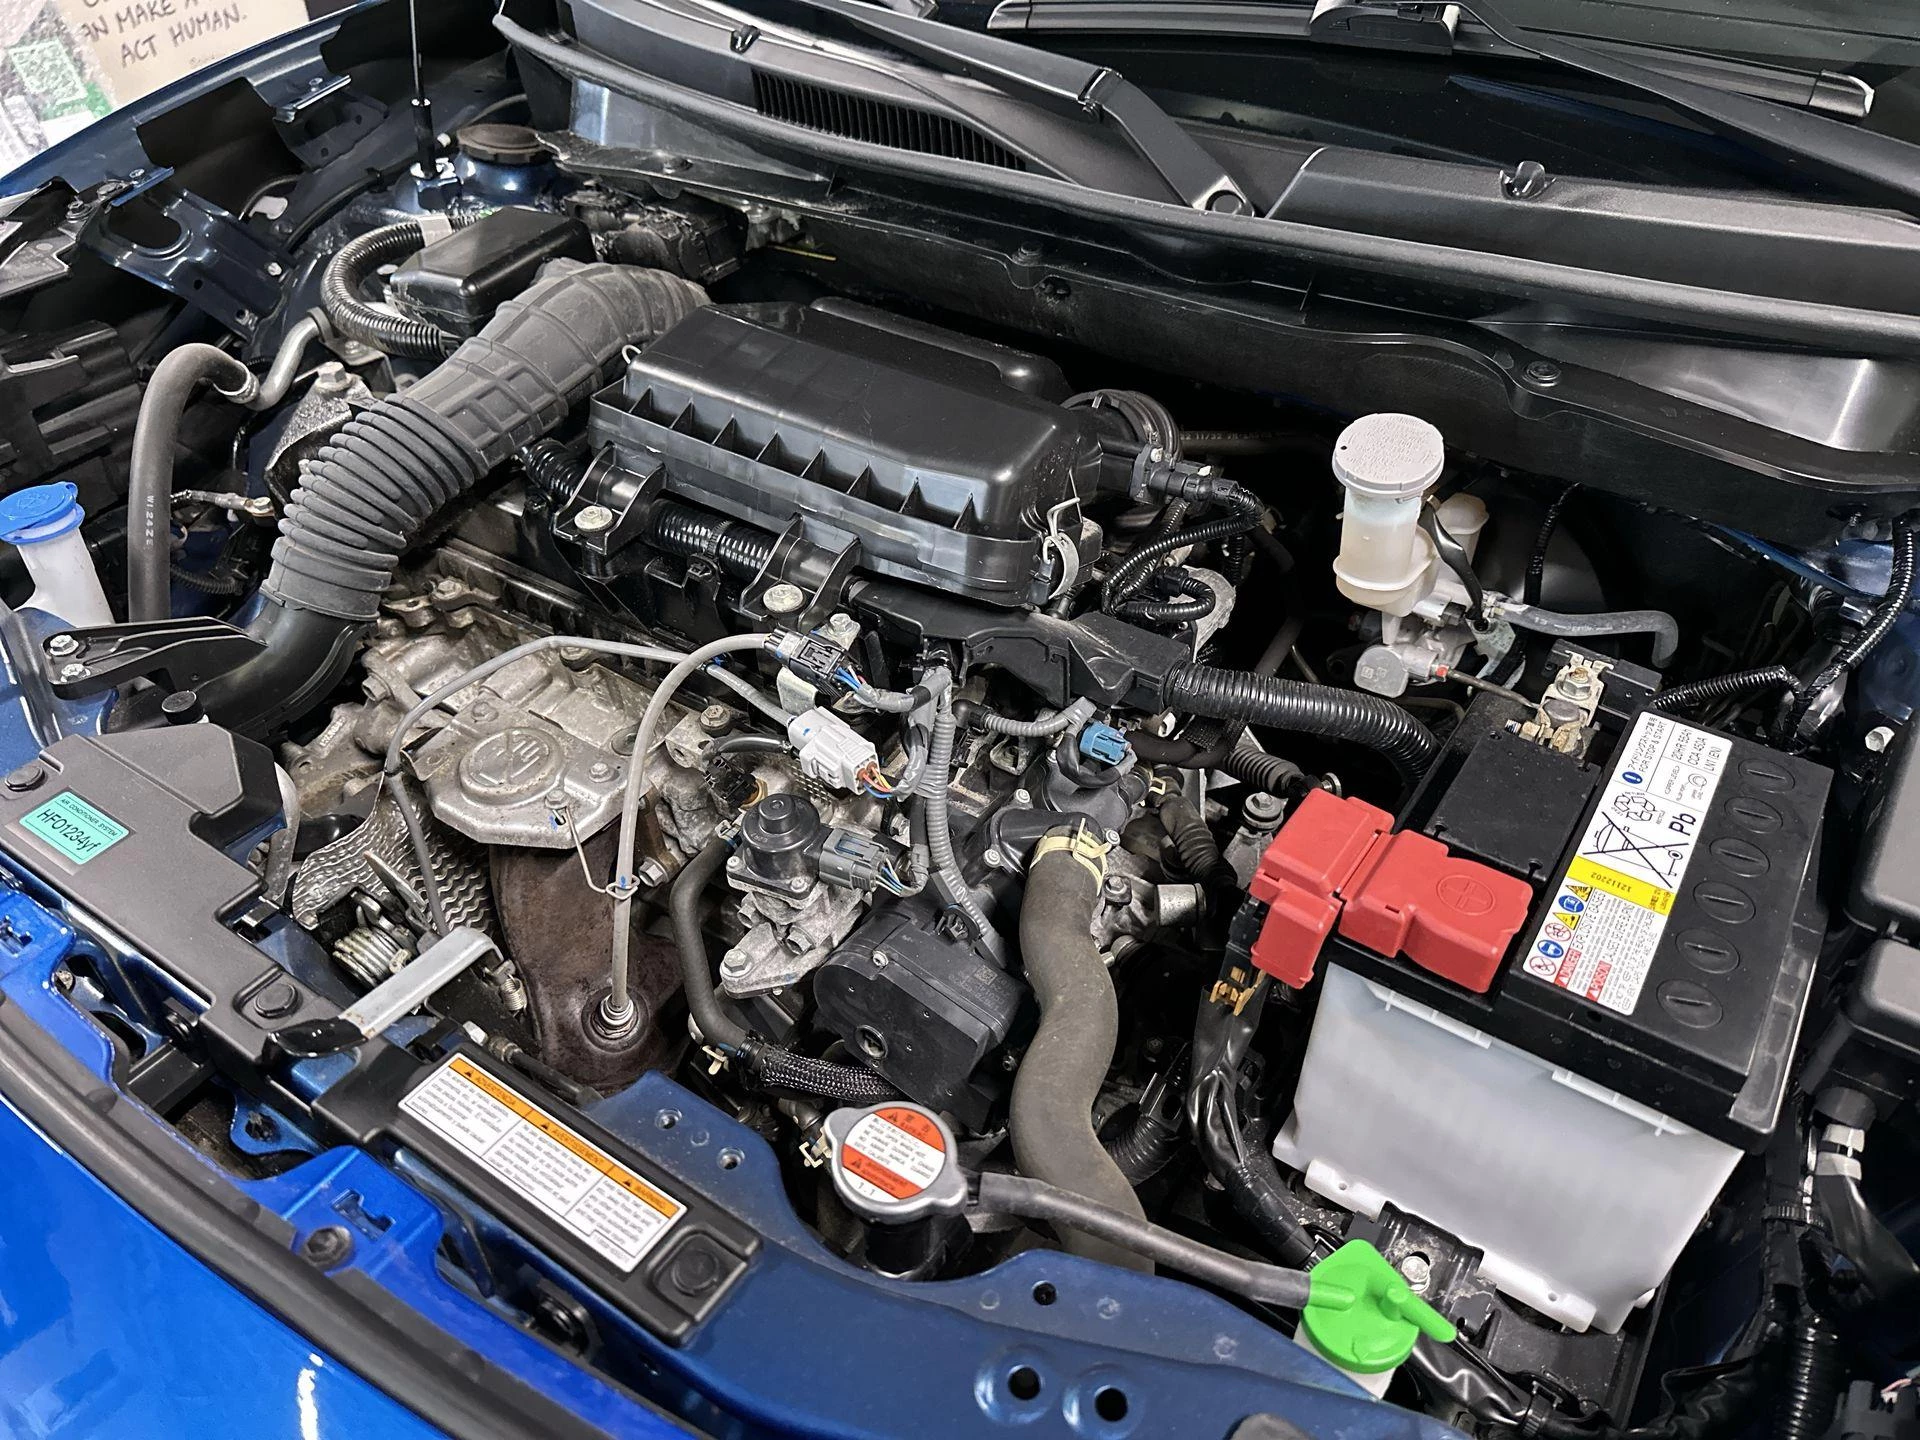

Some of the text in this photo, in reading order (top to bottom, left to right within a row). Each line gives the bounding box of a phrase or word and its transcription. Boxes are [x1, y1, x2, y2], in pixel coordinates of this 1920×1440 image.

[115, 0, 177, 34] MAKE
[120, 34, 158, 68] ACT
[168, 6, 247, 47] HUMAN.
[1639, 760, 1649, 772] FOR
[1644, 744, 1656, 759] STOP
[1653, 721, 1666, 738] START
[37, 809, 102, 852] HFO1234yf
[1668, 810, 1696, 835] Pb
[1560, 948, 1580, 977] DANGER
[1572, 913, 1595, 949] EXPLOSIVE
[1588, 891, 1604, 913] GASES
[1591, 962, 1610, 990] POISON
